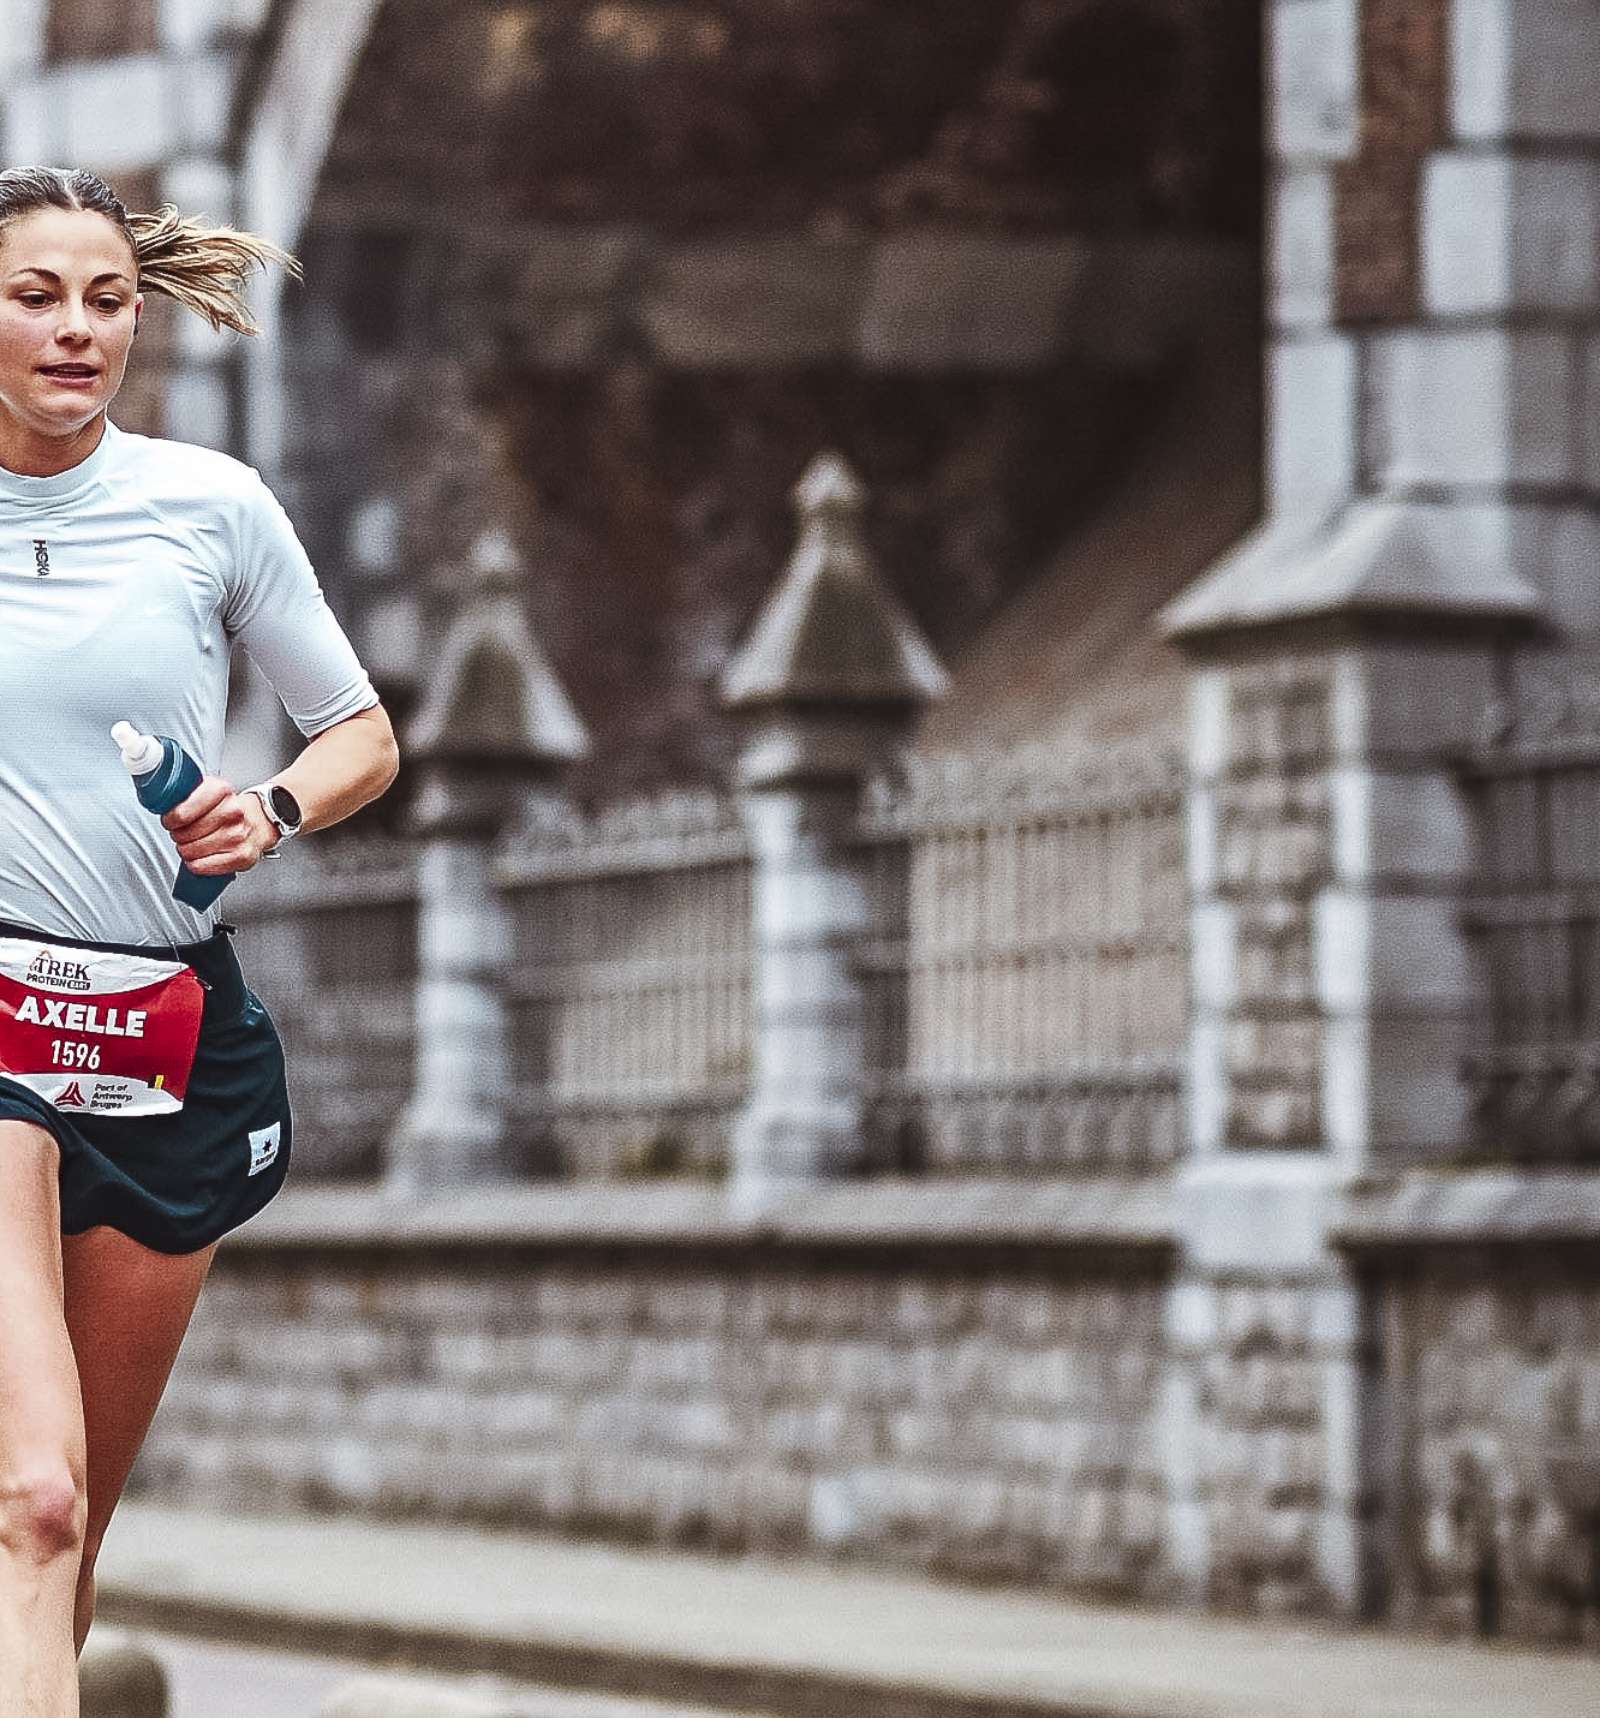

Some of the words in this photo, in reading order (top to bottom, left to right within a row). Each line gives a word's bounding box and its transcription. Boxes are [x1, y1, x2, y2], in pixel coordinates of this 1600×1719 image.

[35, 957, 92, 981] TREK
[26, 973, 67, 987] PROTEIN
[15, 995, 147, 1038] AXELLE
[51, 1040, 101, 1070] 1596
[95, 1083, 115, 1091] Port
[92, 1092, 133, 1102] Antwerp
[90, 1100, 122, 1110] Bruges
